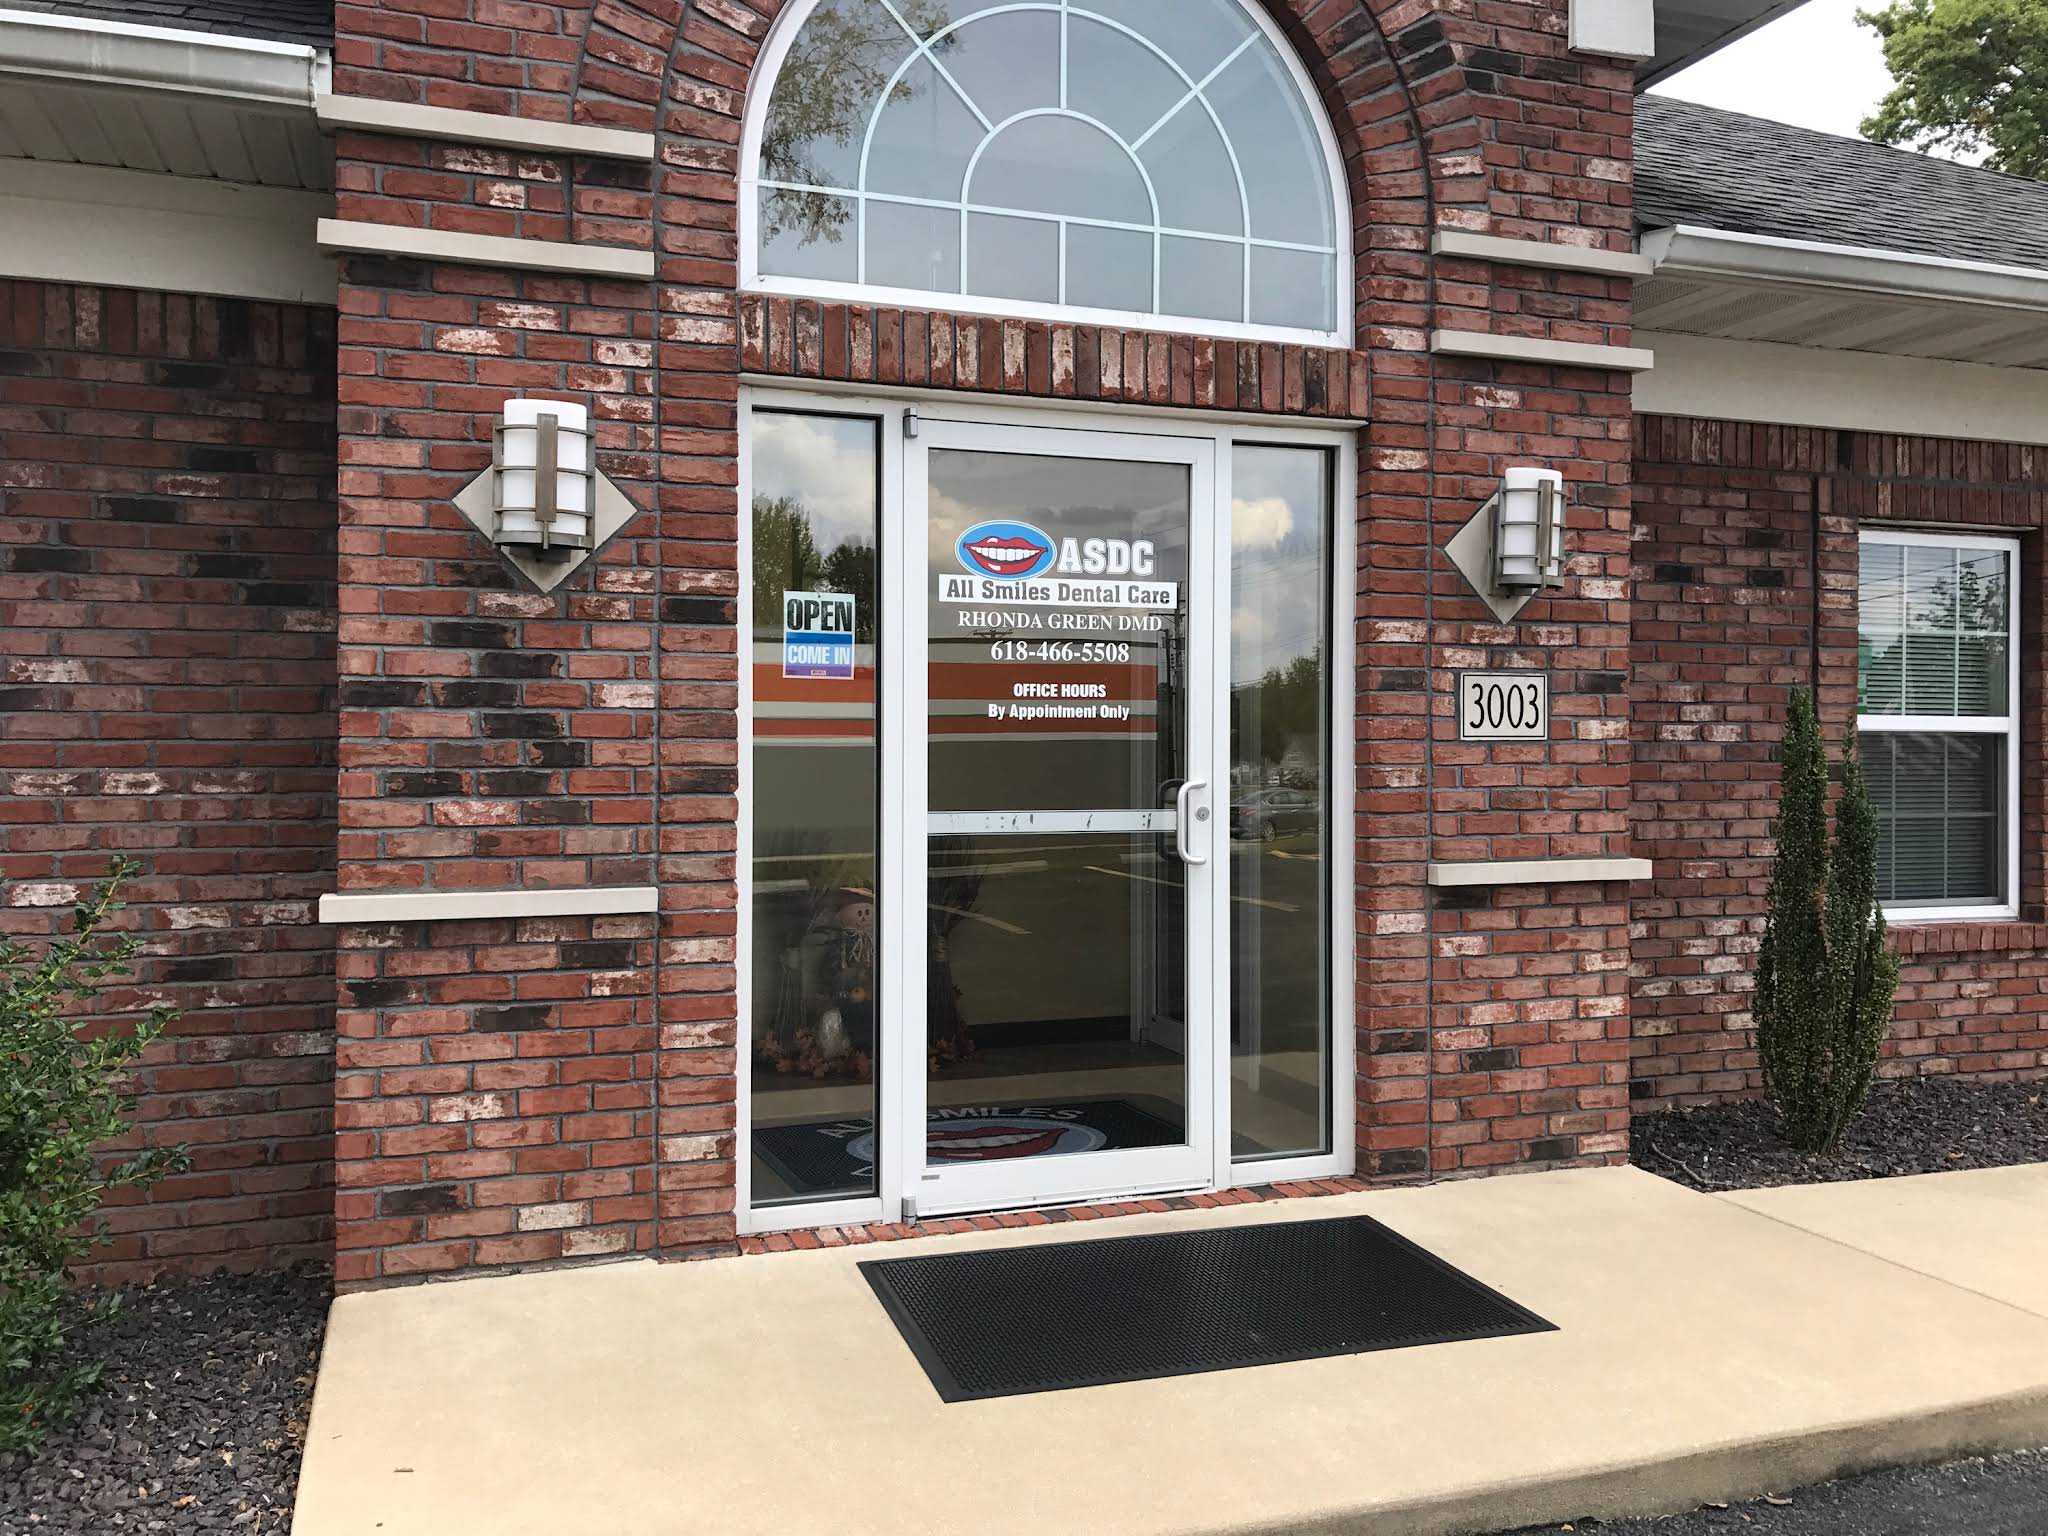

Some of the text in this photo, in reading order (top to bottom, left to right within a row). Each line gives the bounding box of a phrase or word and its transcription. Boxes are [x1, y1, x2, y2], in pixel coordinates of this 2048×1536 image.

[1057, 537, 1154, 576] ASDC
[946, 579, 1170, 605] All Smiles Dental Care
[786, 598, 853, 632] OPEN
[958, 611, 1162, 631] RHONDA GREEN DMD
[788, 645, 850, 665] COME IN
[990, 640, 1130, 663] 618-466-5508
[1013, 683, 1107, 698] OFFICE HOURS
[988, 704, 1130, 721] By Appointment Only
[1469, 683, 1540, 729] 3003
